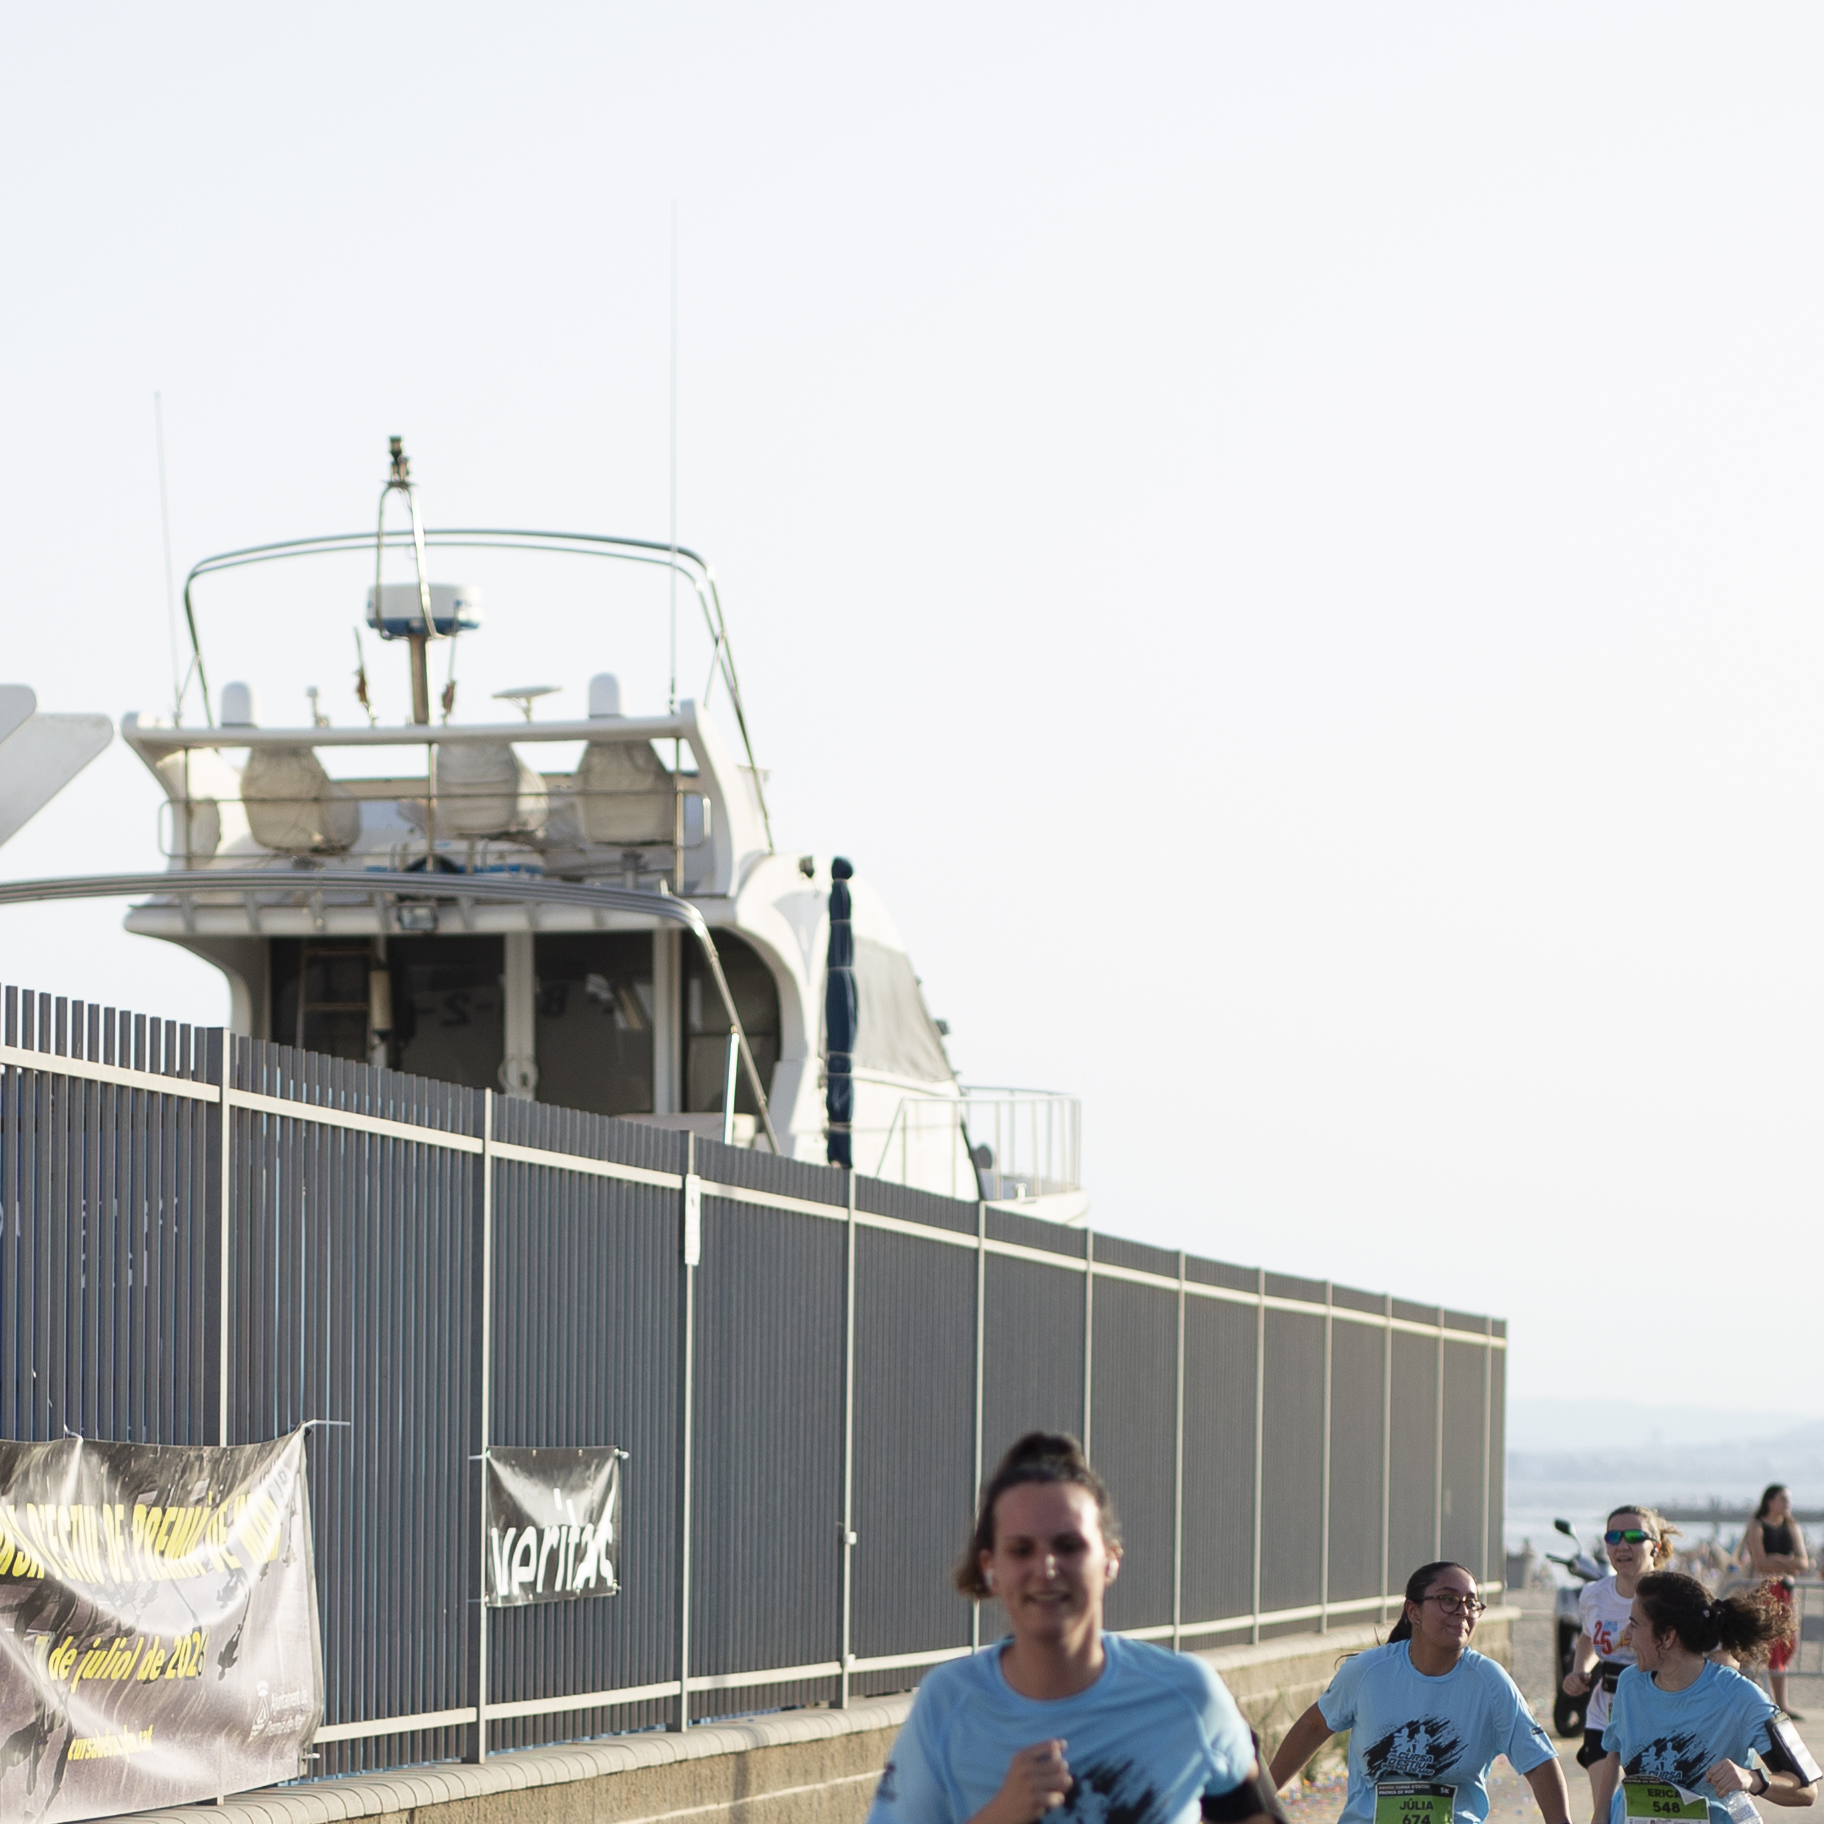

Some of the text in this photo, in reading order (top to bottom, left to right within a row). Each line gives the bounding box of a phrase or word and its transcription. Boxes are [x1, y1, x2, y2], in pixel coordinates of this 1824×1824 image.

[102, 1503, 133, 1583] DE
[1592, 1619, 1613, 1655] 25
[48, 1635, 78, 1681] de
[71, 1636, 145, 1694] juliol
[136, 1635, 166, 1681] de
[1399, 1797, 1434, 1811] JÚLIA
[1652, 1800, 1681, 1813] 548
